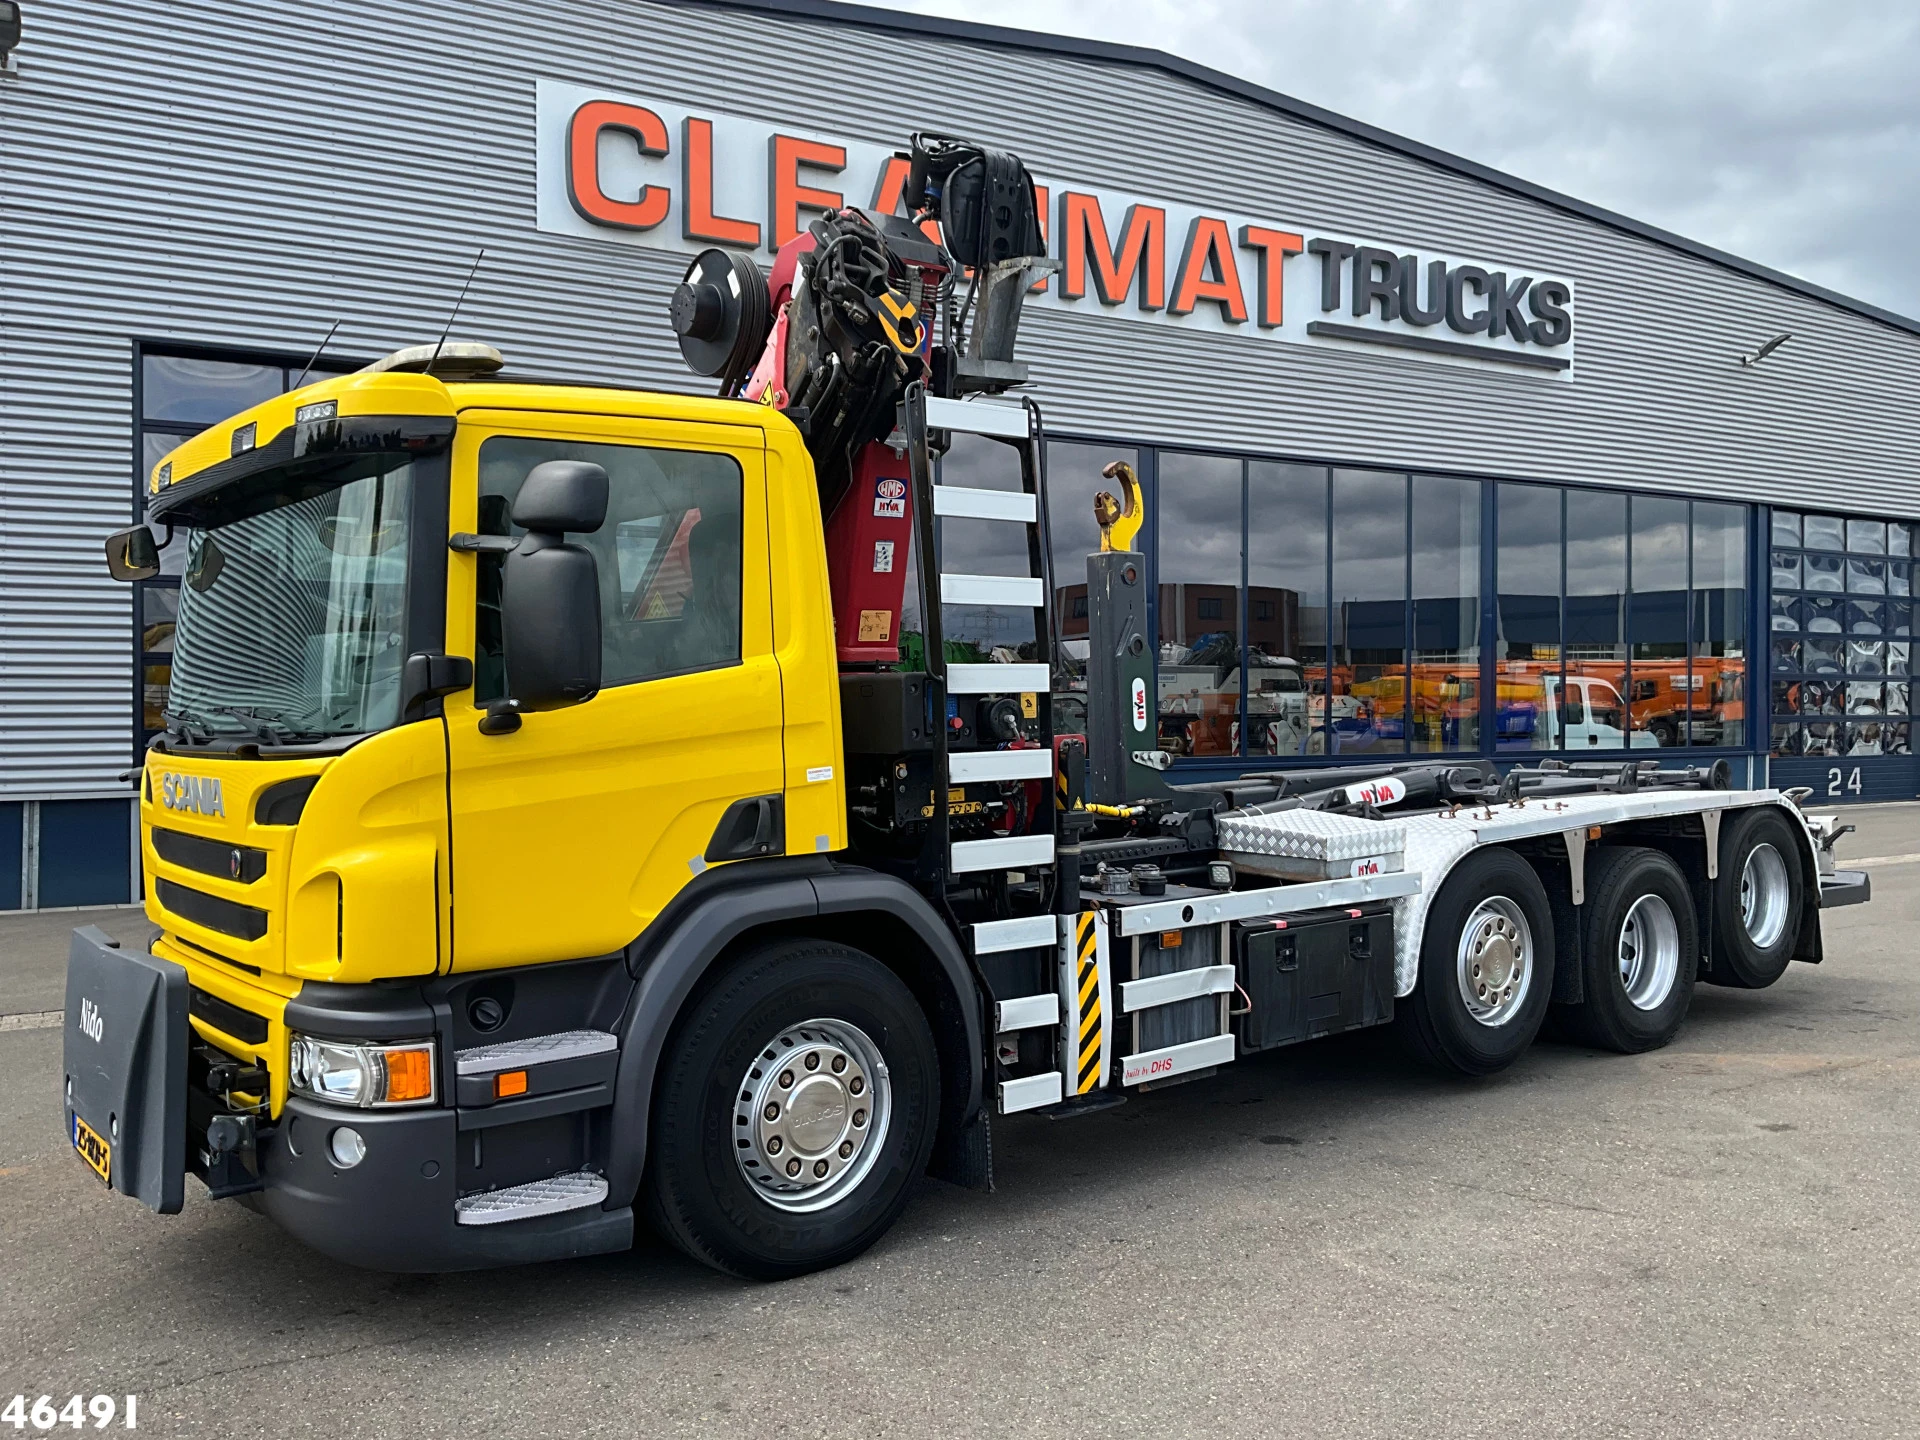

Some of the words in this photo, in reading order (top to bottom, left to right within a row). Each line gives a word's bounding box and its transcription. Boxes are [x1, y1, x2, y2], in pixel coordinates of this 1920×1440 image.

[566, 99, 1304, 330] CLEMAT
[1308, 237, 1571, 347] TRUCKS
[880, 481, 902, 496] HMF
[879, 500, 899, 511] HYVA
[1134, 690, 1144, 719] HYVA
[1360, 783, 1394, 804] HYVA
[1828, 767, 1862, 796] 24
[163, 772, 226, 819] SCANIA
[1357, 860, 1378, 876] HYVA
[79, 997, 103, 1043] Nido
[1151, 1058, 1172, 1074] DHS
